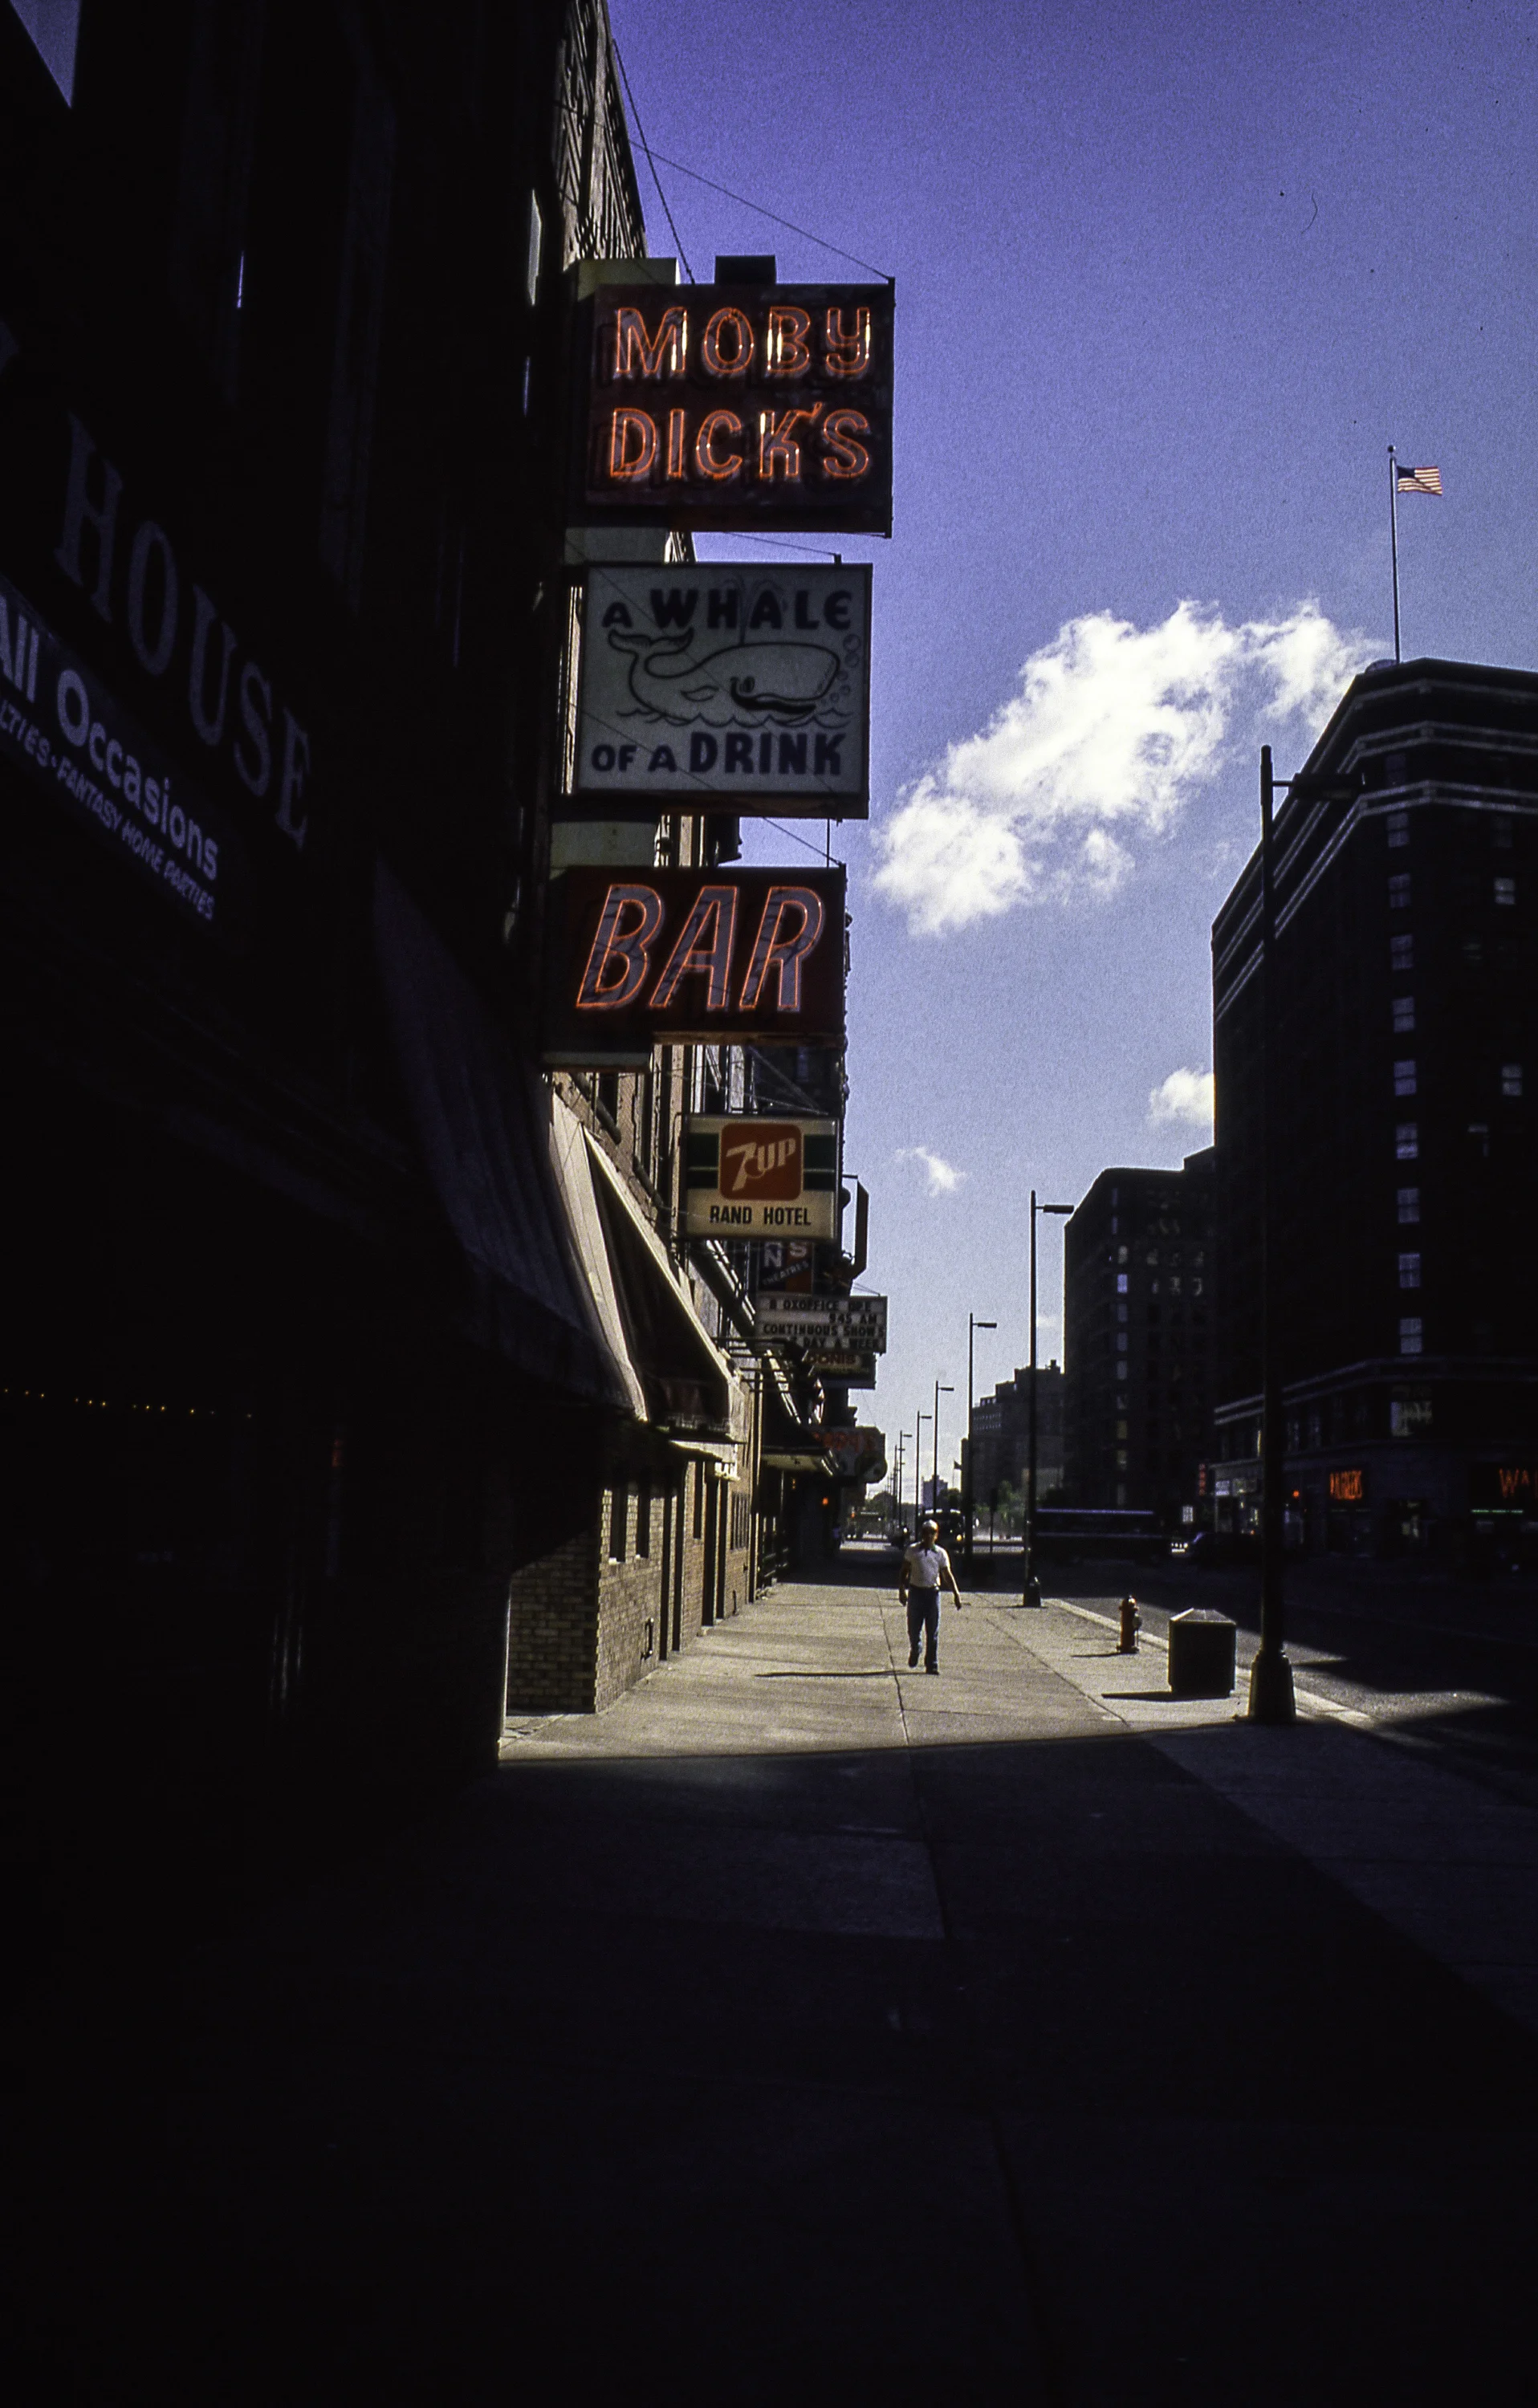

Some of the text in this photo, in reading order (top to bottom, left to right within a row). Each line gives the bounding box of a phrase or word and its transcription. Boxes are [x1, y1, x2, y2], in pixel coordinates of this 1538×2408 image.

[615, 306, 871, 375] MOBY
[608, 401, 871, 480] DICK'S
[52, 408, 311, 852] HOUSE
[600, 588, 854, 630] A WHALE
[56, 668, 220, 881] Occasions
[590, 731, 848, 775] OF A DRINK
[55, 754, 124, 832] FANTASY
[120, 818, 166, 875] HOME
[163, 856, 216, 921] PARTIES
[575, 883, 825, 1011] BAR
[710, 1205, 812, 1226] RAND HOTEL
